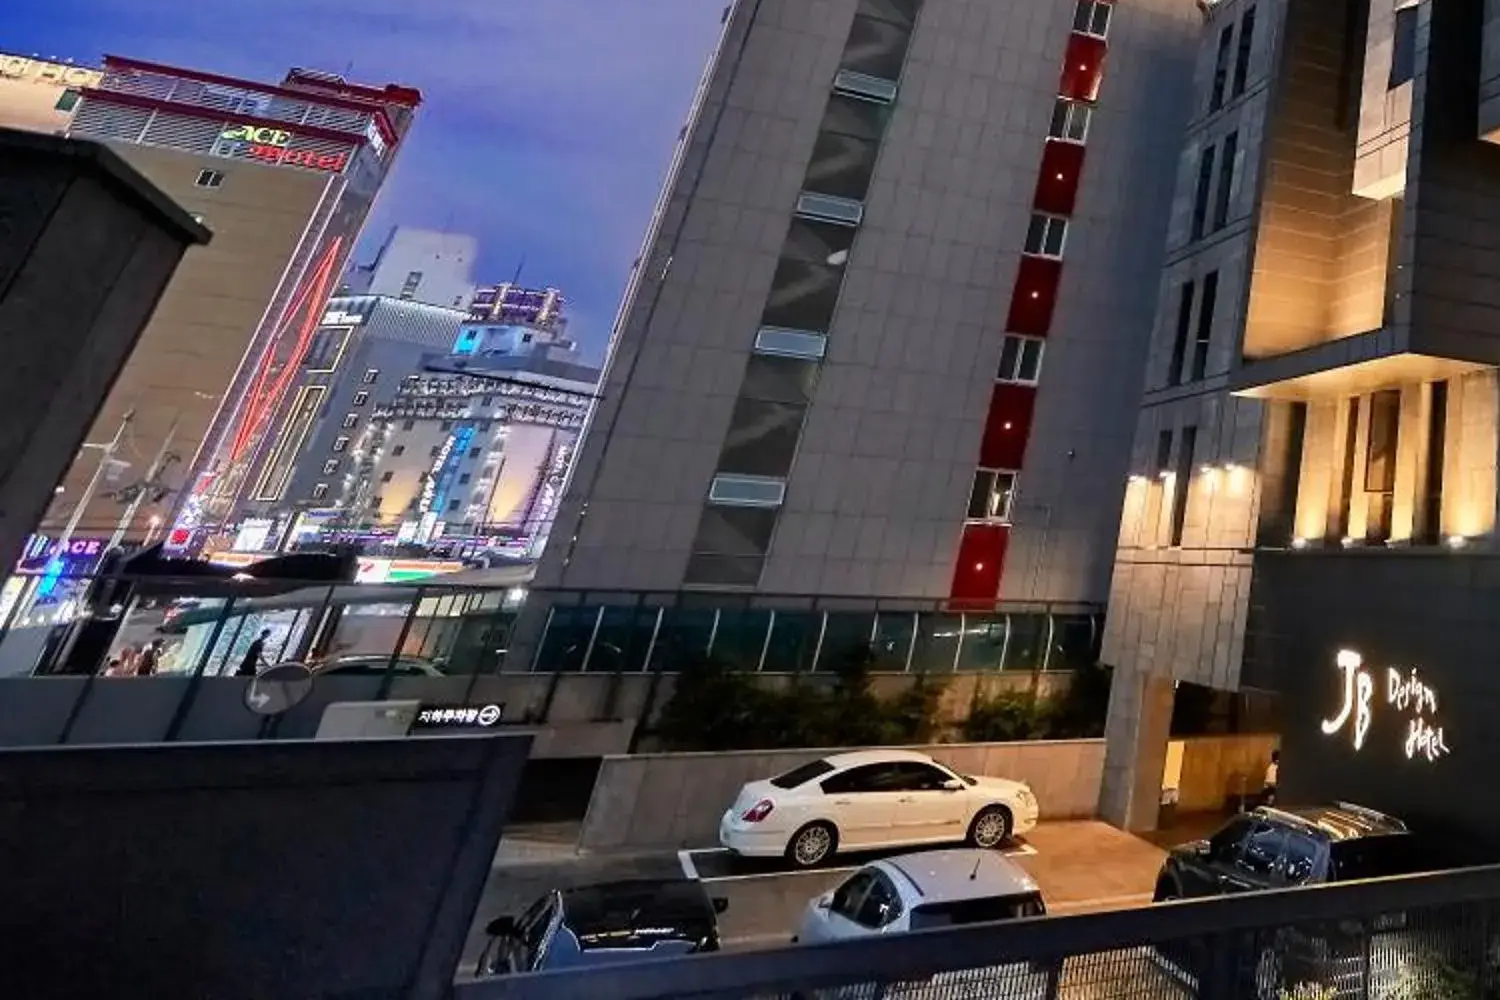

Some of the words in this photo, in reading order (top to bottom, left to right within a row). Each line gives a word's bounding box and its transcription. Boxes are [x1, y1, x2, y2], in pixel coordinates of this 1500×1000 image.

[1320, 648, 1374, 752] JB
[1388, 666, 1438, 714] Design
[1404, 715, 1451, 763] Hotel
